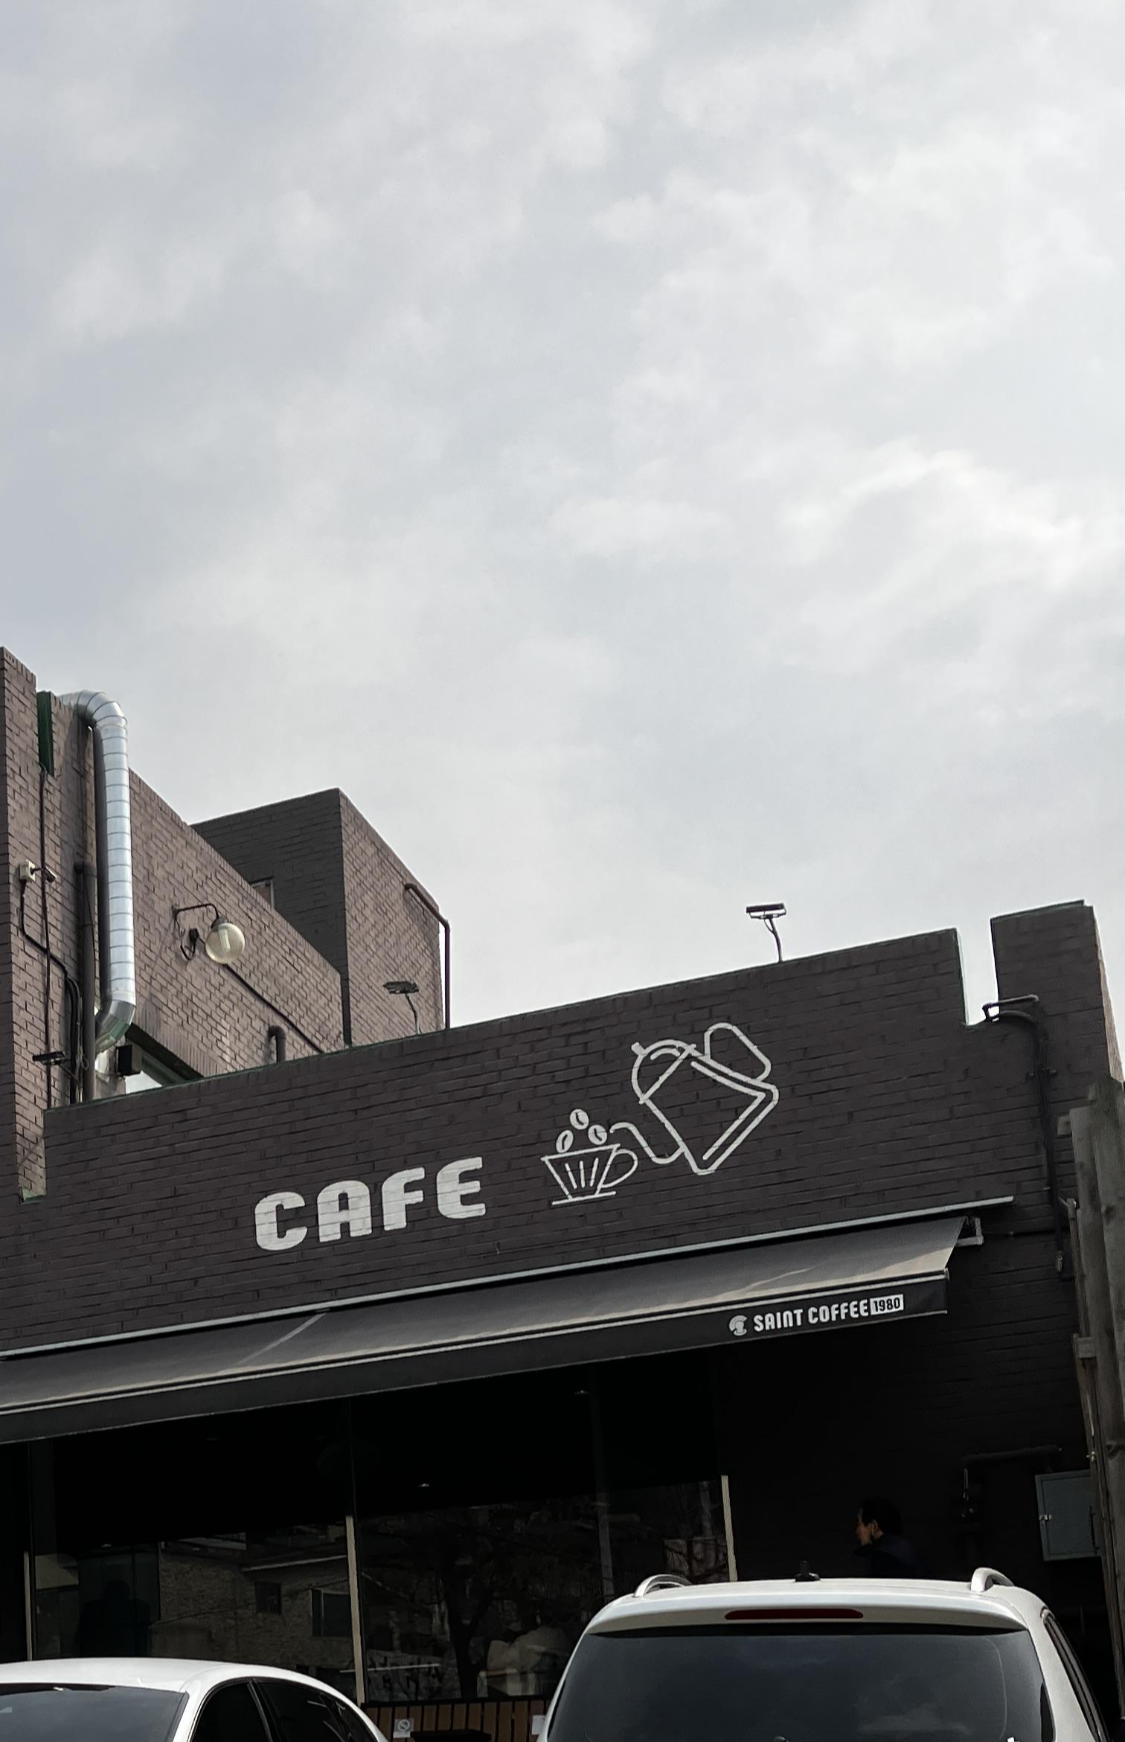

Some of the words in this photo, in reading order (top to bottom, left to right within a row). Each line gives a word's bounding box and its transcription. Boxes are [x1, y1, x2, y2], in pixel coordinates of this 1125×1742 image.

[254, 1156, 486, 1251] CAFE
[753, 1309, 803, 1332] SAINT
[807, 1299, 869, 1324] COFFEE
[872, 1296, 902, 1313] 1980
